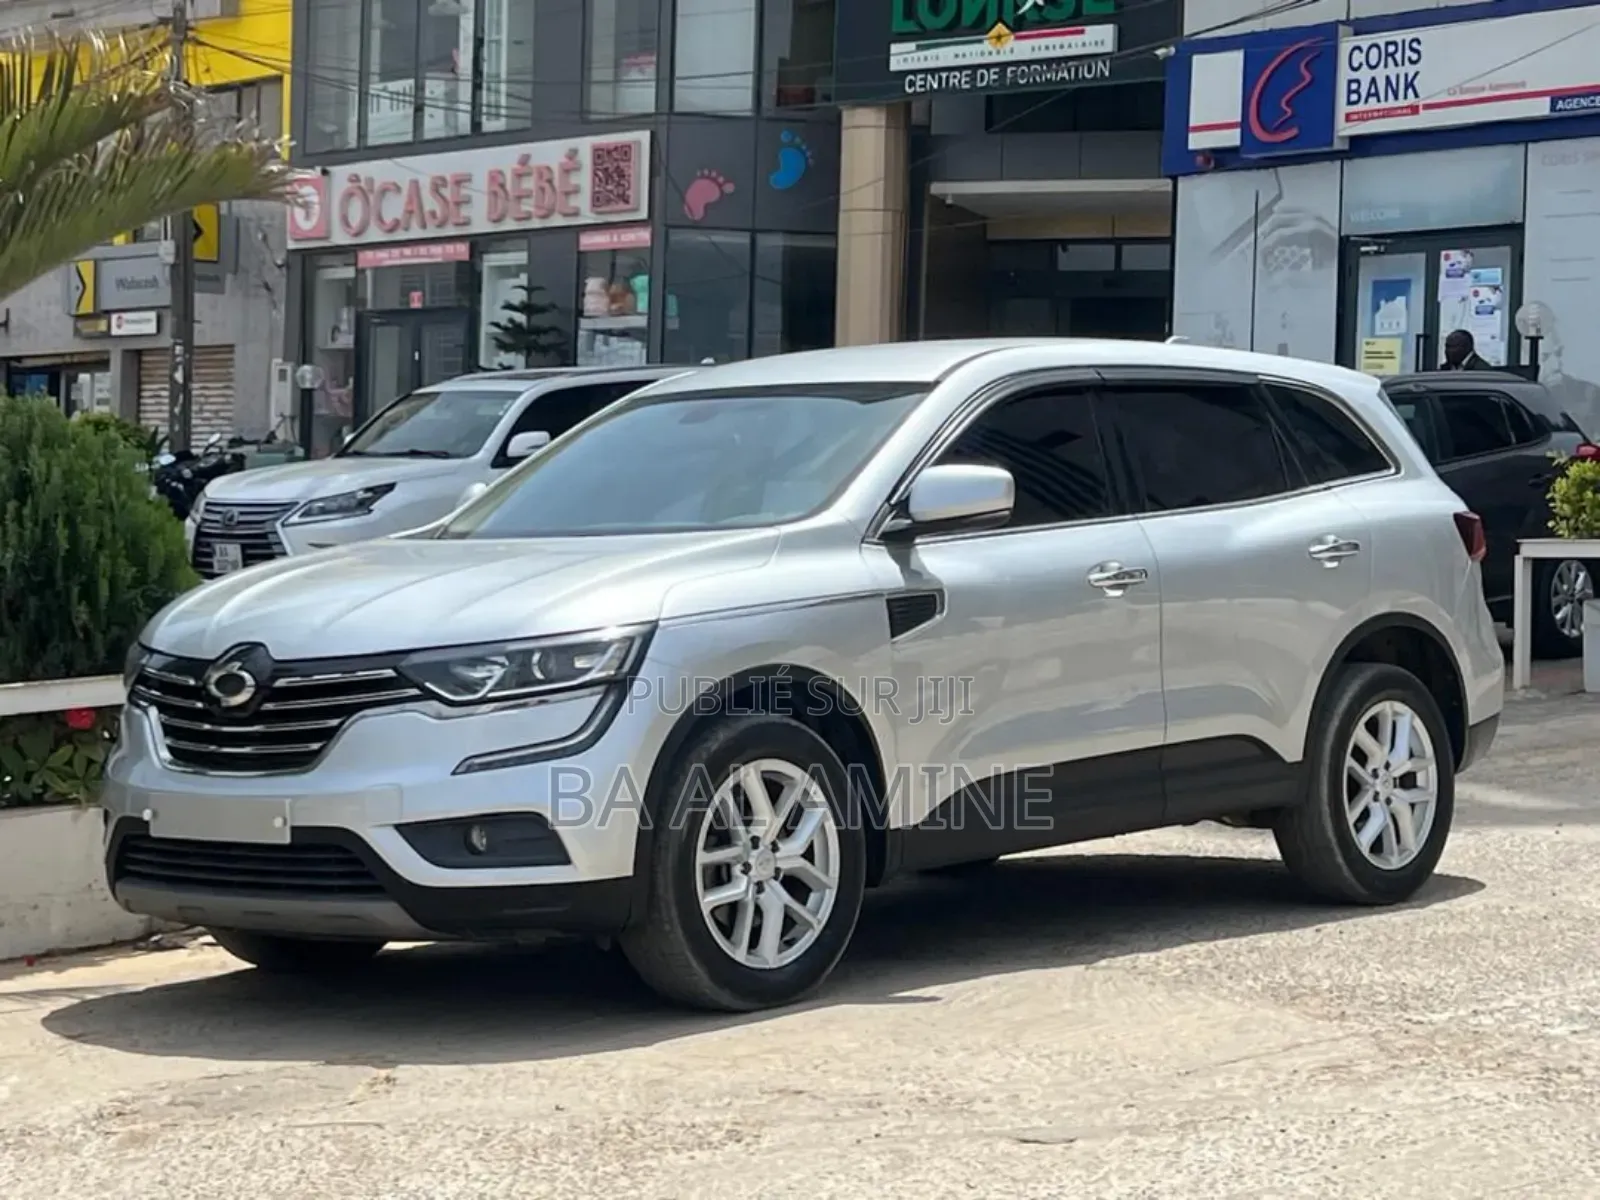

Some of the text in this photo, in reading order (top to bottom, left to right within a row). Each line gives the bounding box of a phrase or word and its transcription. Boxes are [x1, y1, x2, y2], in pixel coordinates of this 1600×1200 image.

[1348, 37, 1423, 72] CORIS
[904, 59, 1111, 94] CENTRE DE FORMATION
[1346, 71, 1421, 106] BANK
[486, 148, 581, 223] BÉBÉ
